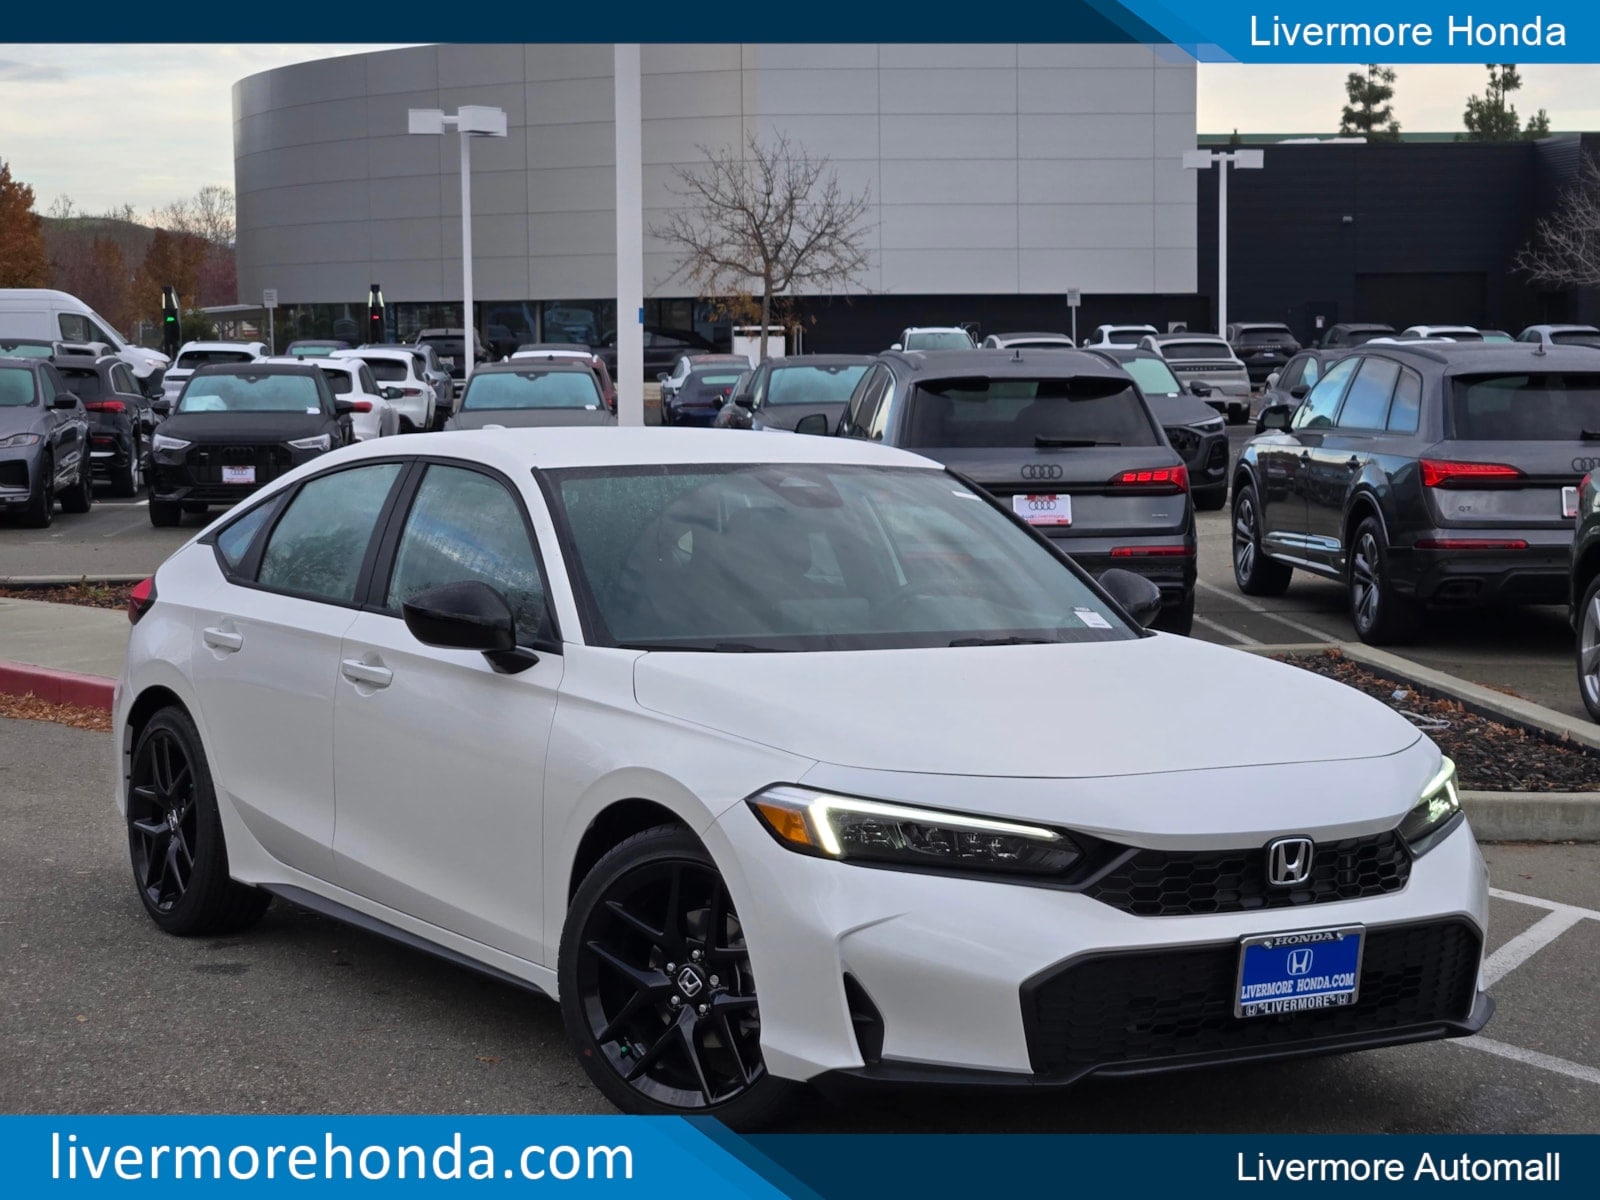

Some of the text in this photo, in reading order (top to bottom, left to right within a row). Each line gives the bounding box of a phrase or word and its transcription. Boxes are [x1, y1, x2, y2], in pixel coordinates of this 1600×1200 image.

[1274, 932, 1335, 946] HONDA
[1241, 973, 1355, 1000] LIVERMORE HONDA.COM
[1264, 995, 1331, 1014] LIVERMORE
